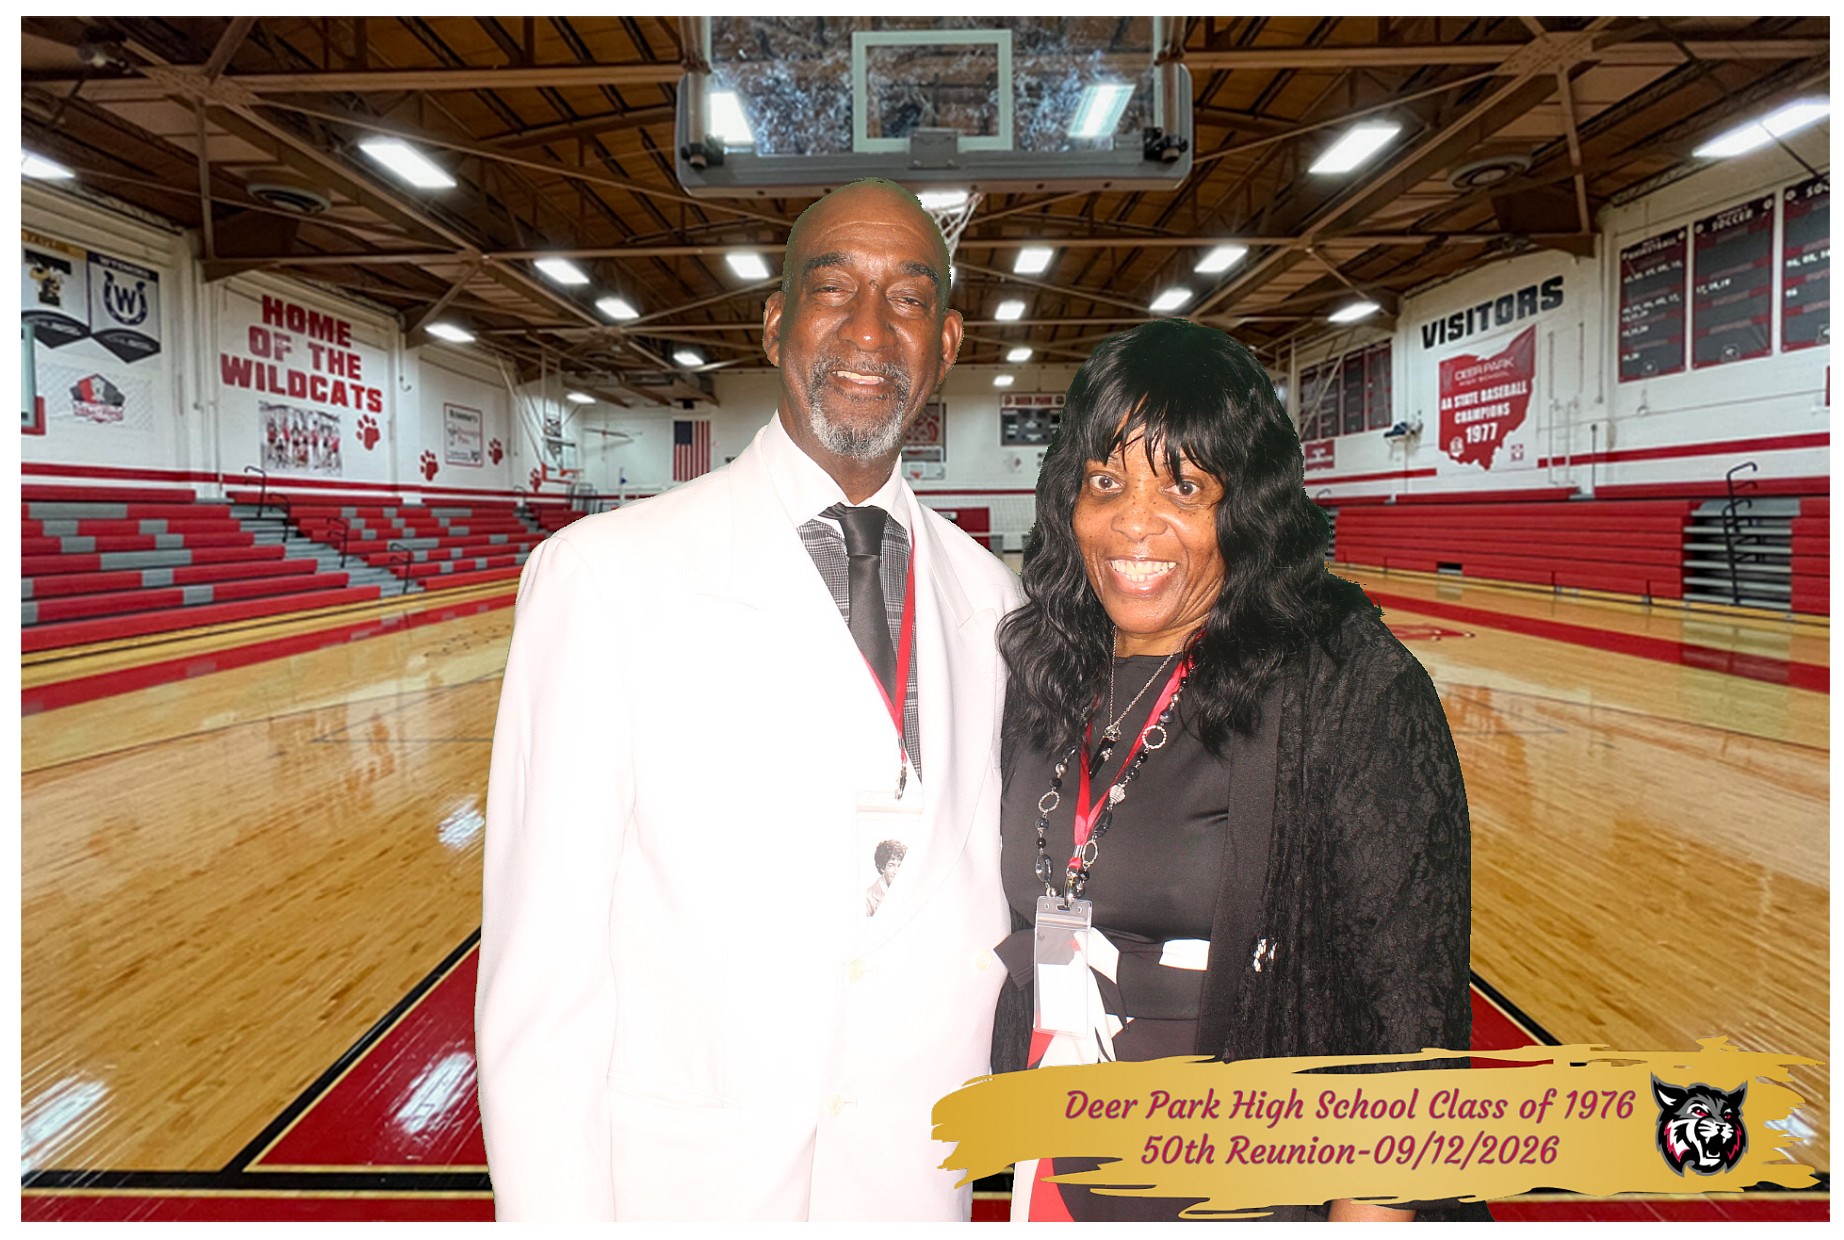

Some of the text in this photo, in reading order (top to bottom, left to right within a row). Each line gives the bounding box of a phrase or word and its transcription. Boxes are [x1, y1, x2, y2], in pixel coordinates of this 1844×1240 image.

[1711, 209, 1753, 232] SOCCER
[114, 284, 137, 314] W
[1421, 275, 1564, 349] VISITORS
[262, 294, 351, 349] HOME
[248, 325, 361, 380] OF THE
[220, 353, 382, 413] WILDCATS
[1455, 356, 1514, 381] DEER PARK
[1441, 380, 1528, 410] AA STATE BASEBALL
[1454, 402, 1511, 425] CHAMPIONS
[1465, 422, 1498, 444] 1977
